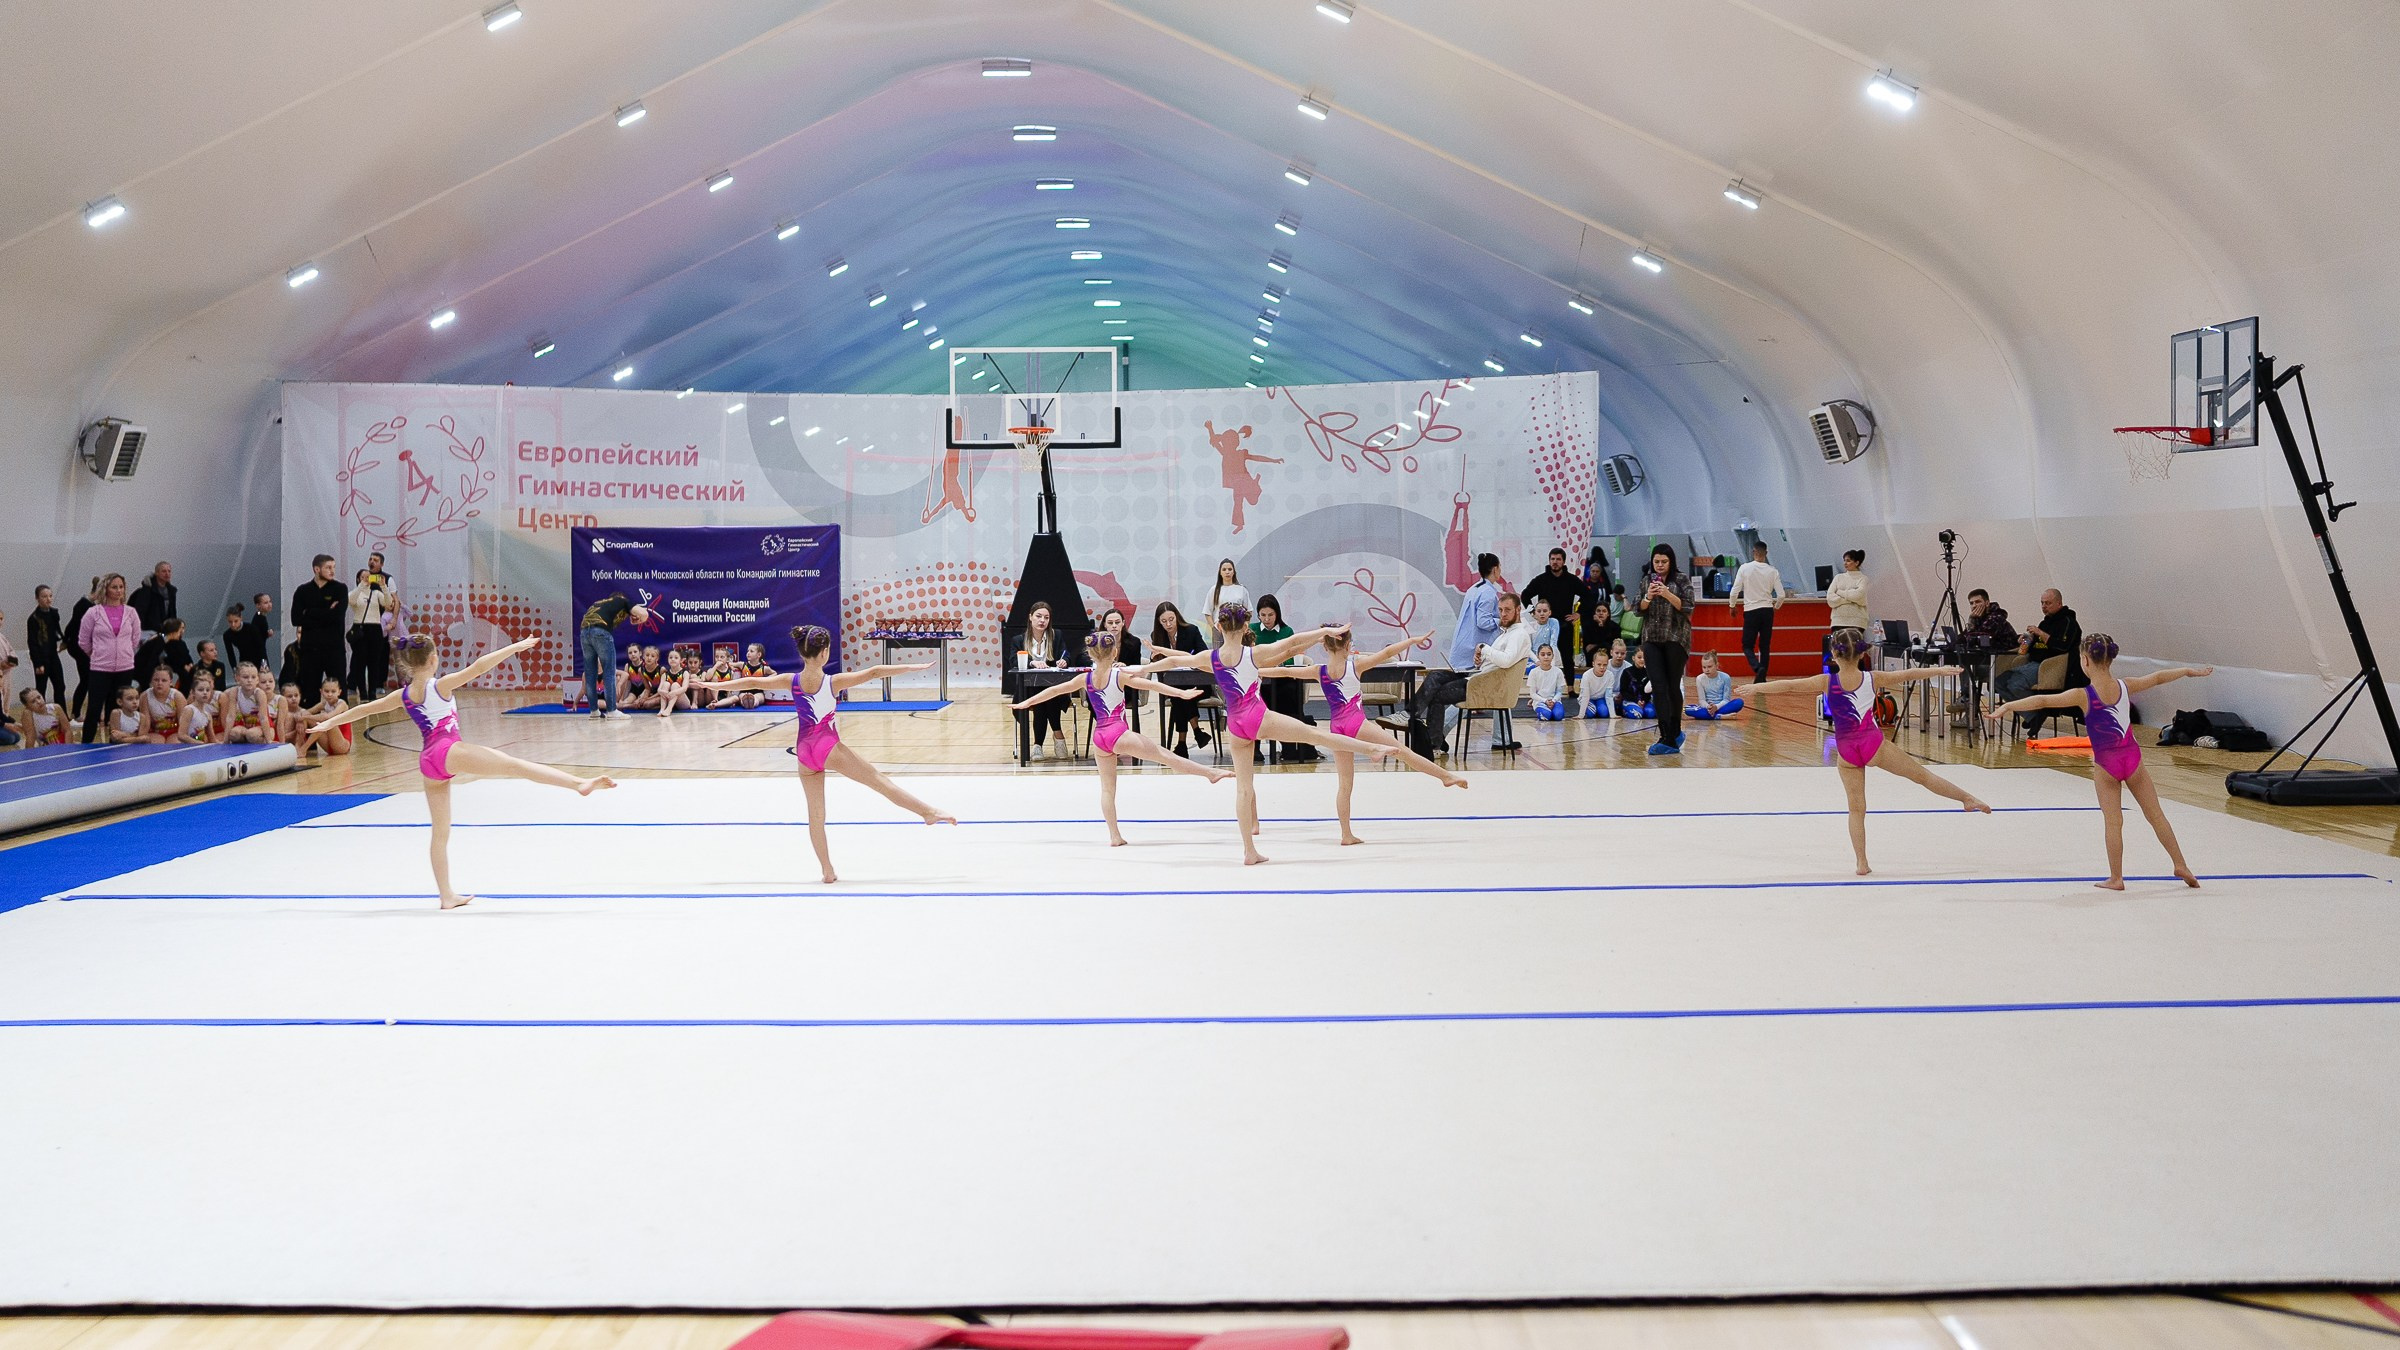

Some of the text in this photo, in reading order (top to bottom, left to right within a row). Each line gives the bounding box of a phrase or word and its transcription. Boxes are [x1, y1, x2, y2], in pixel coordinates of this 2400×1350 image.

[518, 441, 698, 467] Европейский
[518, 474, 745, 502] Гимнастический
[605, 541, 654, 549] СпортВилл
[591, 568, 821, 581] Кубок Москвы и Московской области по Командной гимнастике
[672, 598, 770, 611] Федерация Командной
[672, 611, 756, 624] Гимнастики России
